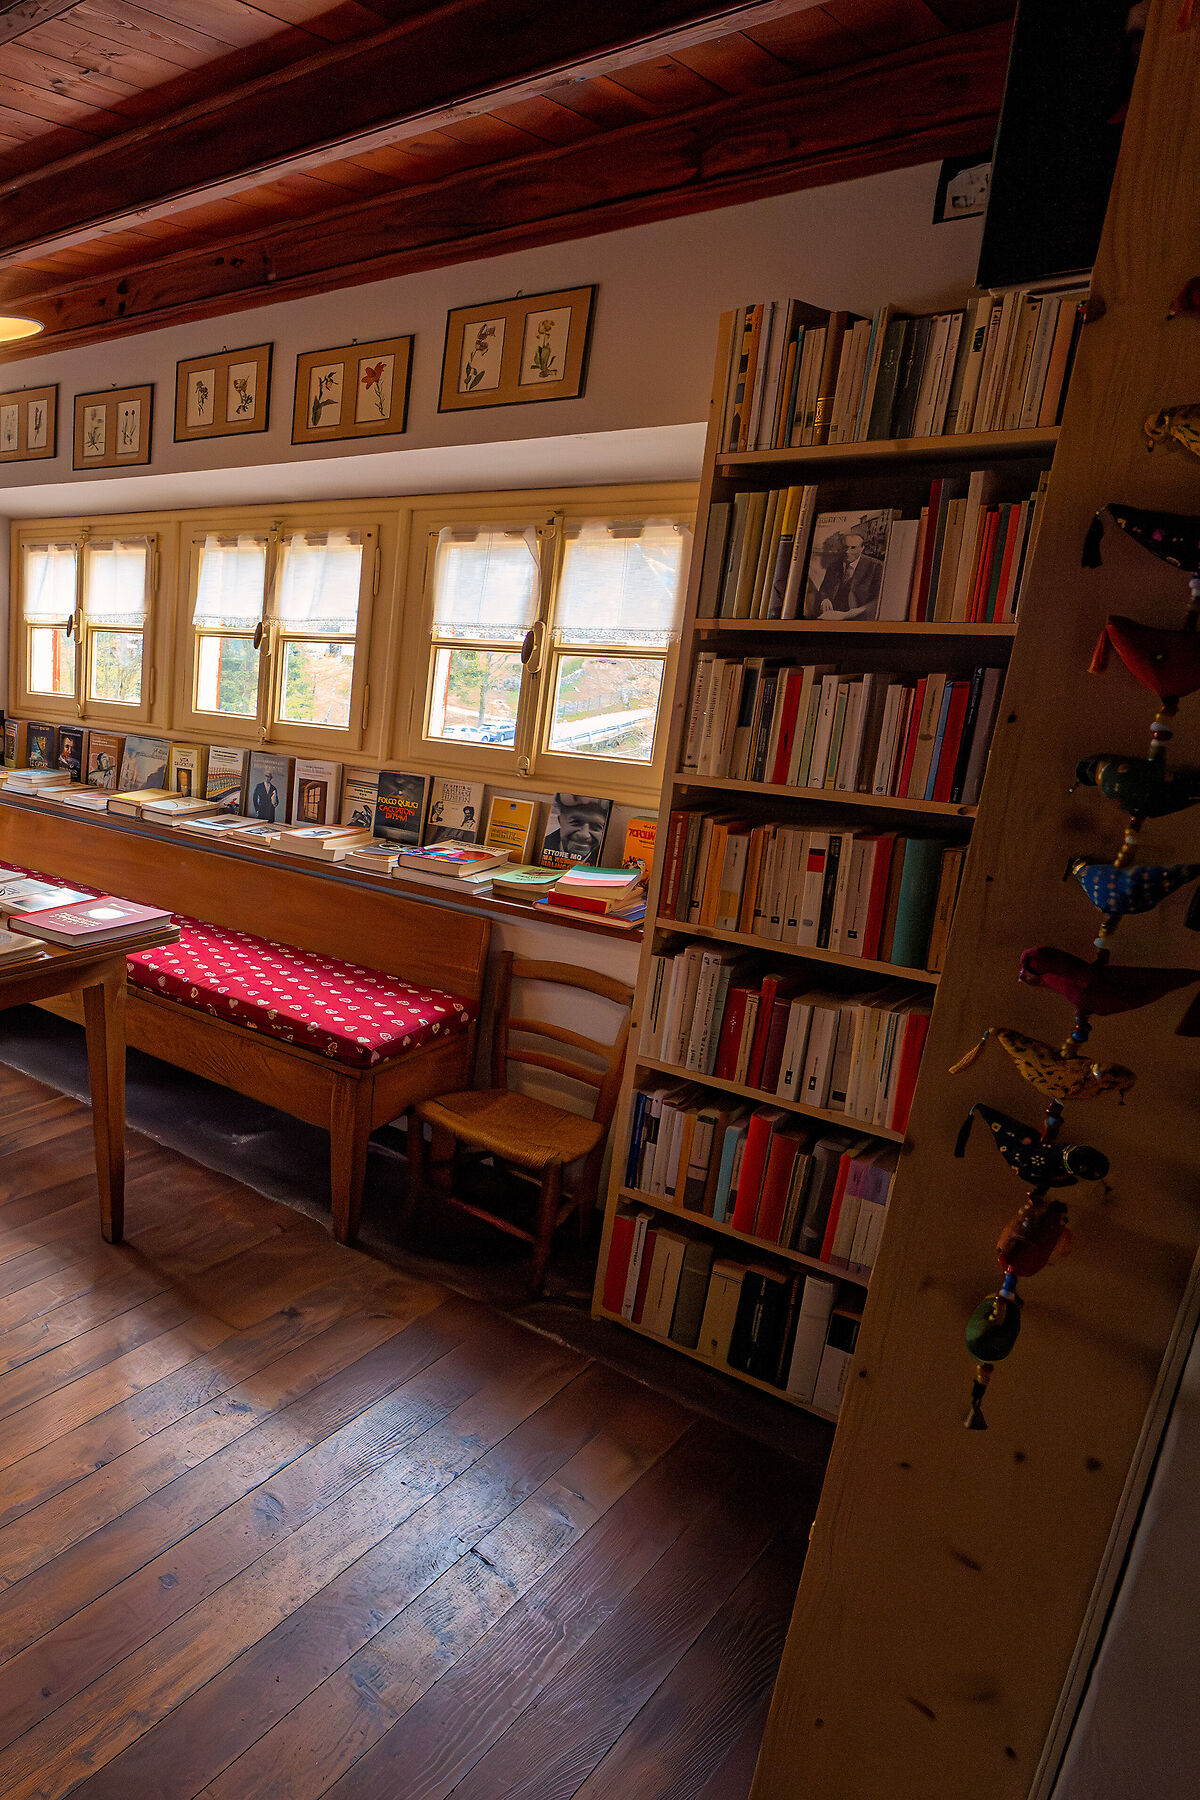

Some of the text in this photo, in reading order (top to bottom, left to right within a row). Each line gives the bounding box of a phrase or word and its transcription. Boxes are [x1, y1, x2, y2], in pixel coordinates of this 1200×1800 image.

[377, 796, 398, 805] FOLCO
[543, 848, 583, 861] ETTORE MO
